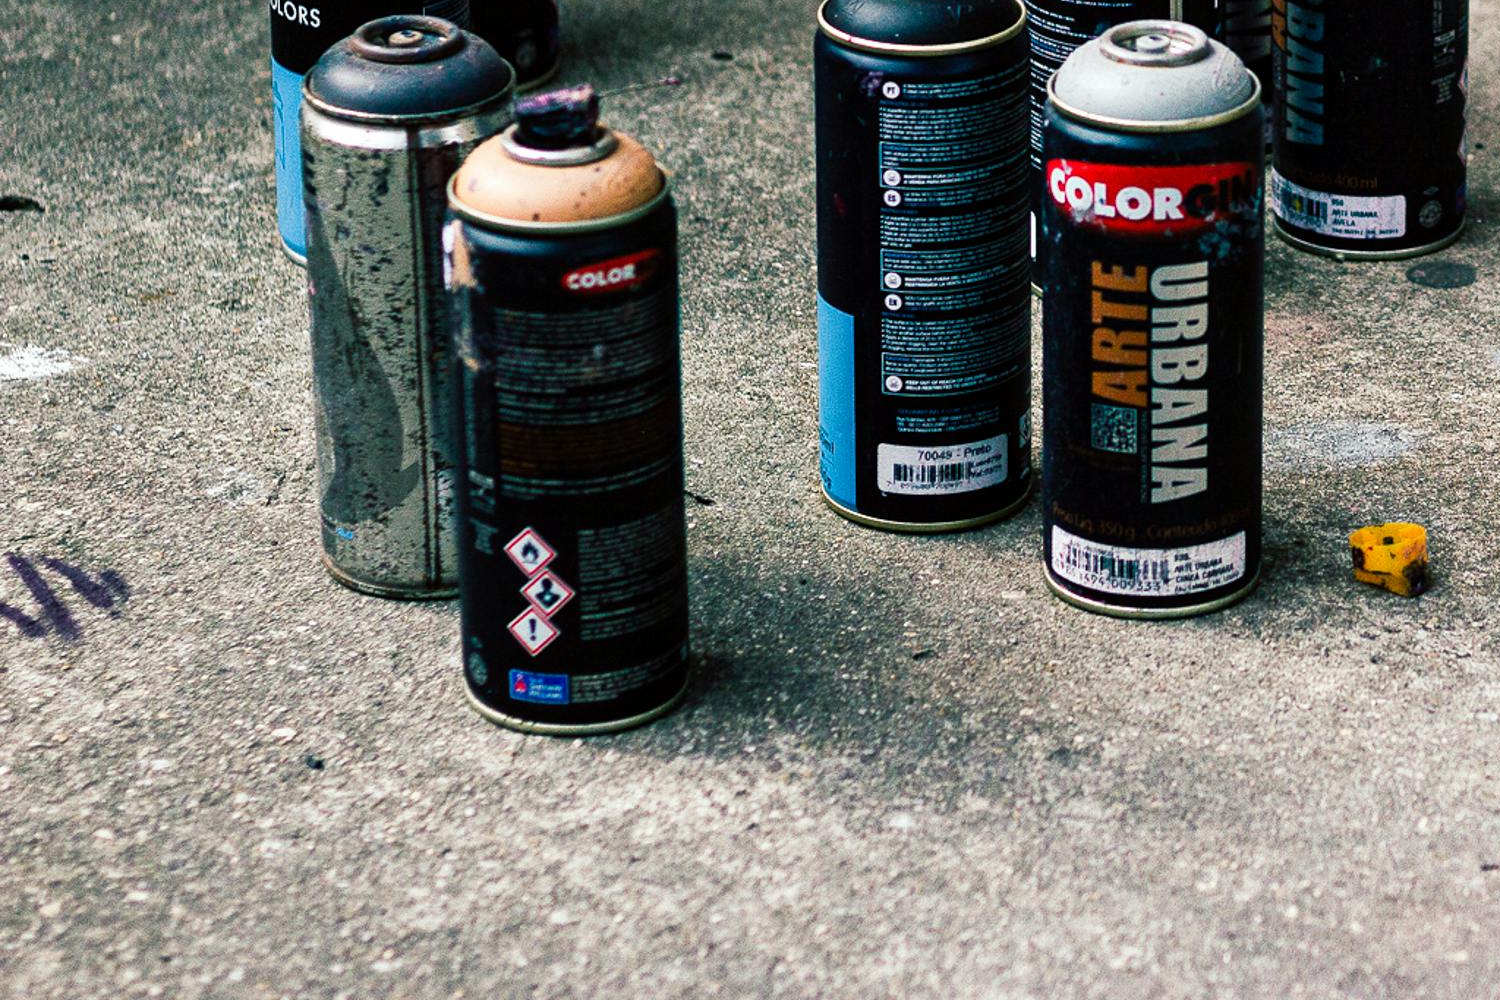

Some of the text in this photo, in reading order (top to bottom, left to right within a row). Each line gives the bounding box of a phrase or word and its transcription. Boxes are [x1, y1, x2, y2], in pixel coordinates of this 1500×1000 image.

[1050, 166, 1253, 221] COLORGIN
[1091, 260, 1148, 408] ARTE
[1150, 261, 1208, 503] URBANA
